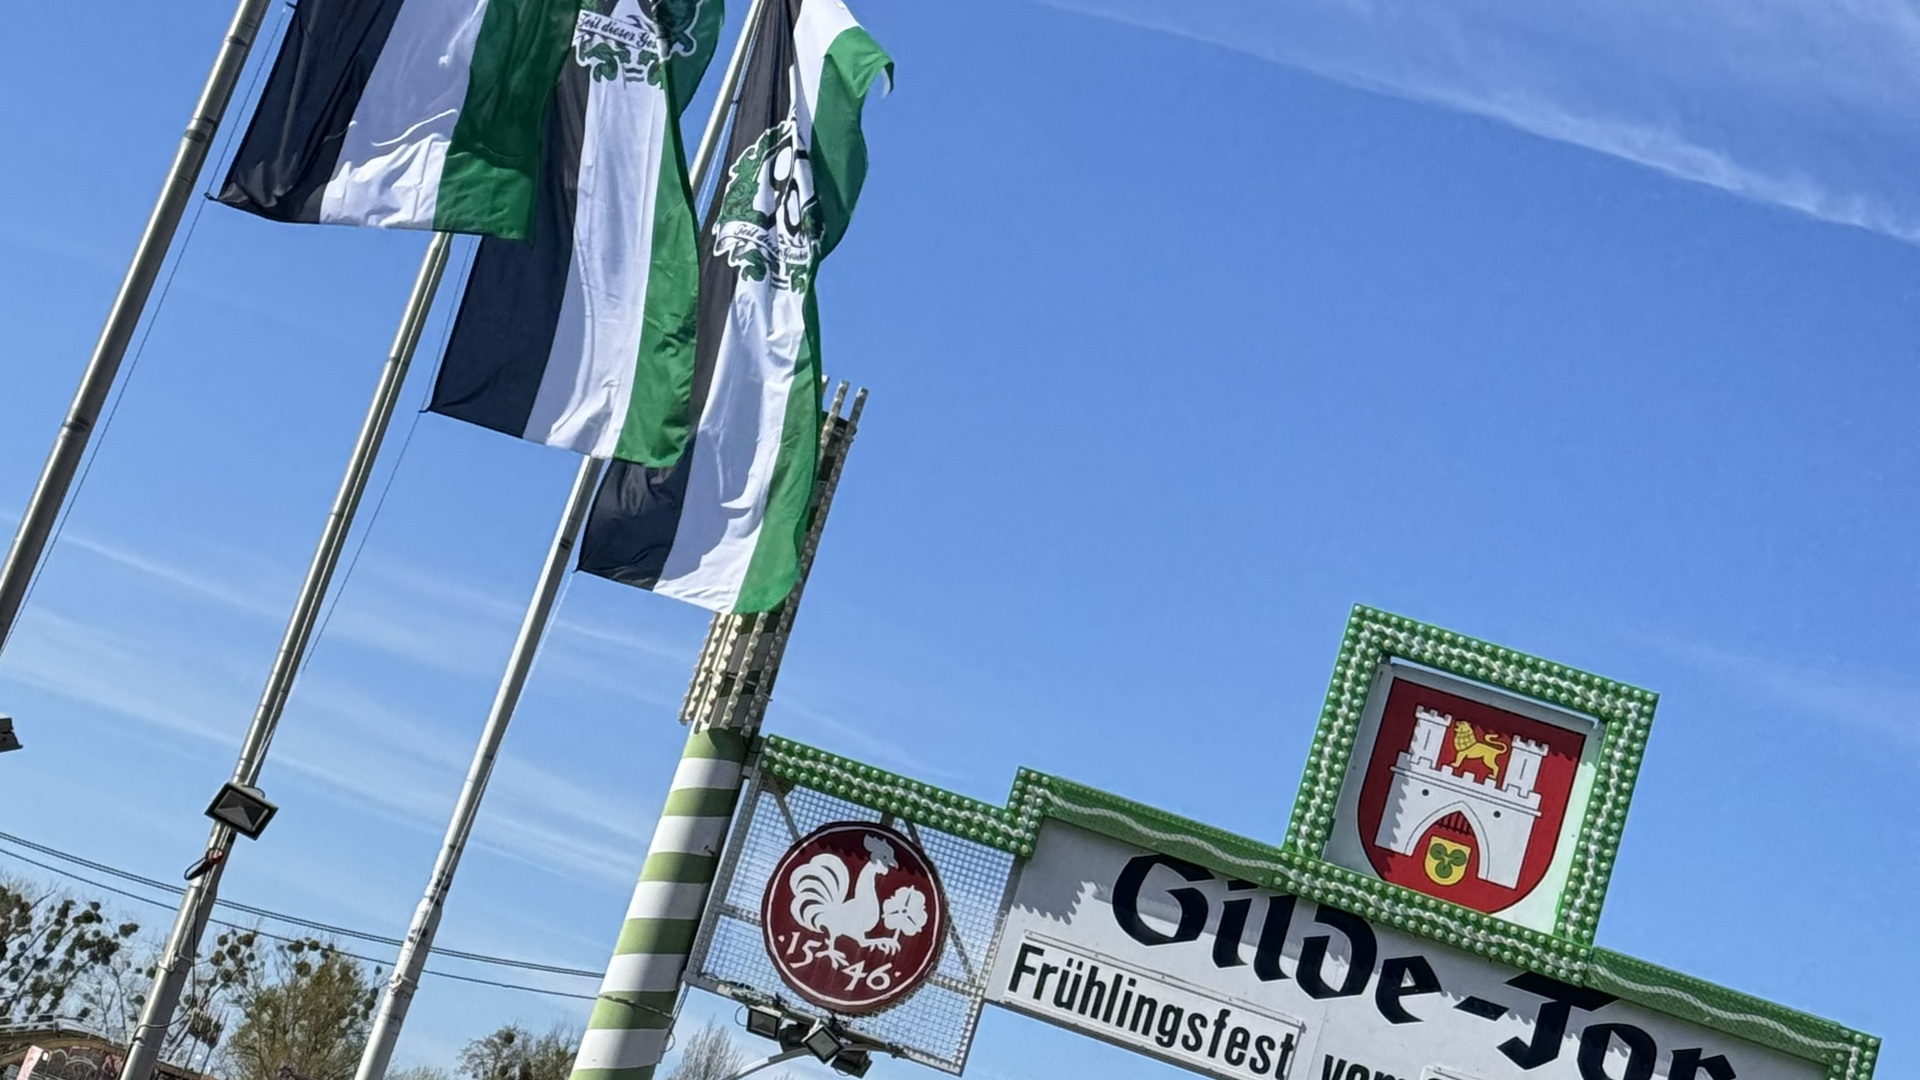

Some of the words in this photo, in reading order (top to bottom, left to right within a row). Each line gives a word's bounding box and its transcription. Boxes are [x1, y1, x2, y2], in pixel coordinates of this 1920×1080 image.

[578, 13, 601, 29] Teil
[733, 223, 759, 237] Teil
[1007, 942, 1295, 1080] Frühlingsfest
